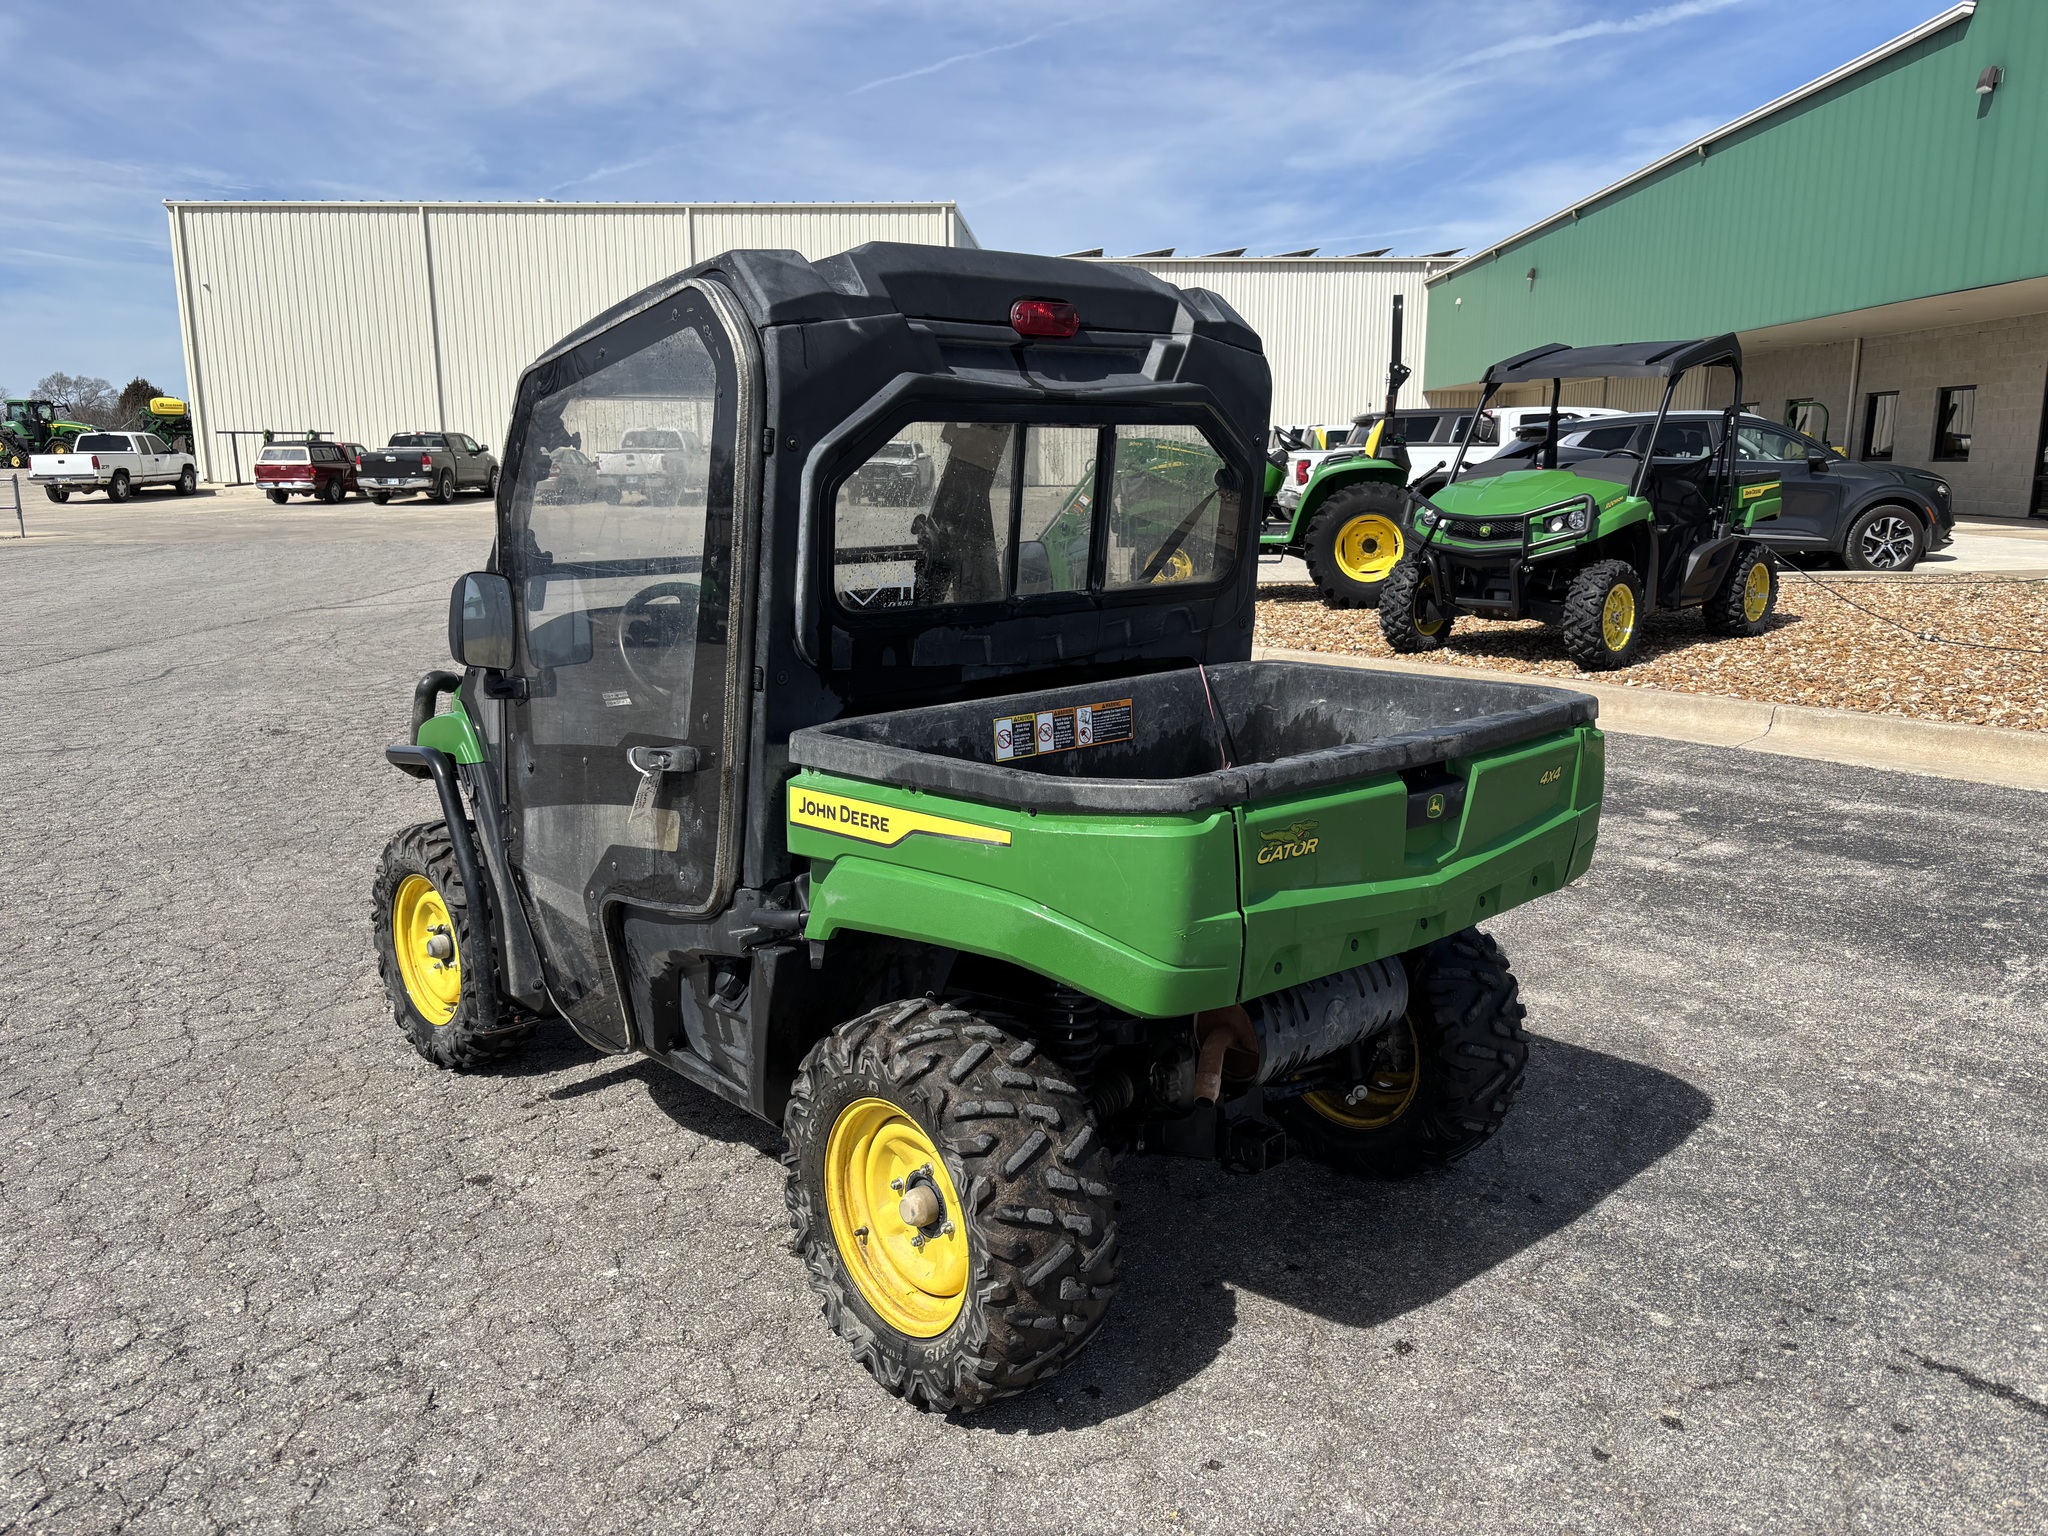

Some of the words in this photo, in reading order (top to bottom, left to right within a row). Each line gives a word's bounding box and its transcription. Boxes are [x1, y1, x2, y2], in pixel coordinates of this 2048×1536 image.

[799, 796, 836, 820] JOHN
[840, 805, 889, 833] DEERE
[1257, 838, 1319, 865] GATOR
